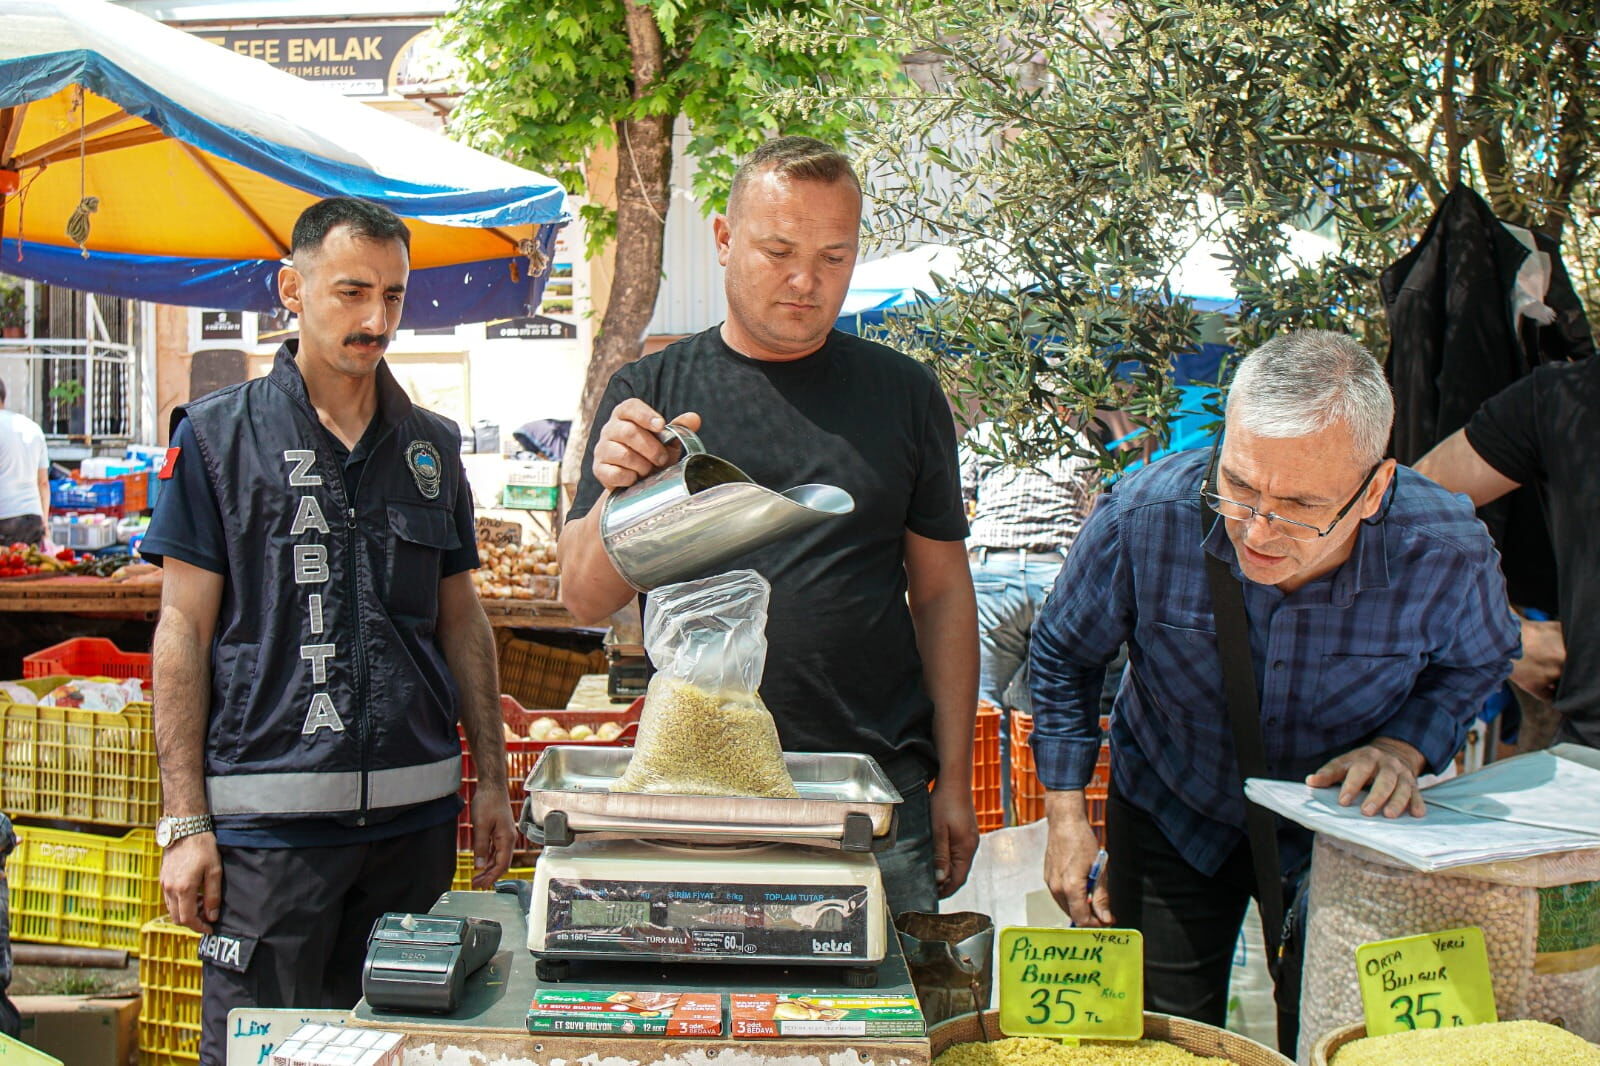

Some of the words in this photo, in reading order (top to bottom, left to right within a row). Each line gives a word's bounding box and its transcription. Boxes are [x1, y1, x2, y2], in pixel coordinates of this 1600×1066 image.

[287, 36, 383, 63] EMLAK
[284, 449, 345, 735] ZABITA
[764, 893, 797, 901] TOPLAM
[199, 933, 241, 966] ABITA
[724, 935, 736, 950] 60
[812, 938, 853, 954] betsa
[1020, 963, 1102, 987] BULGUR
[1365, 950, 1402, 977] ORTA
[1025, 988, 1082, 1025] 35
[1085, 1011, 1103, 1023] TL
[1390, 991, 1442, 1030] 35
[554, 1020, 564, 1029] ET
[565, 1021, 584, 1030] SUYU
[643, 1023, 652, 1032] 12
[680, 1022, 688, 1034] 3
[737, 1021, 746, 1033] 3
